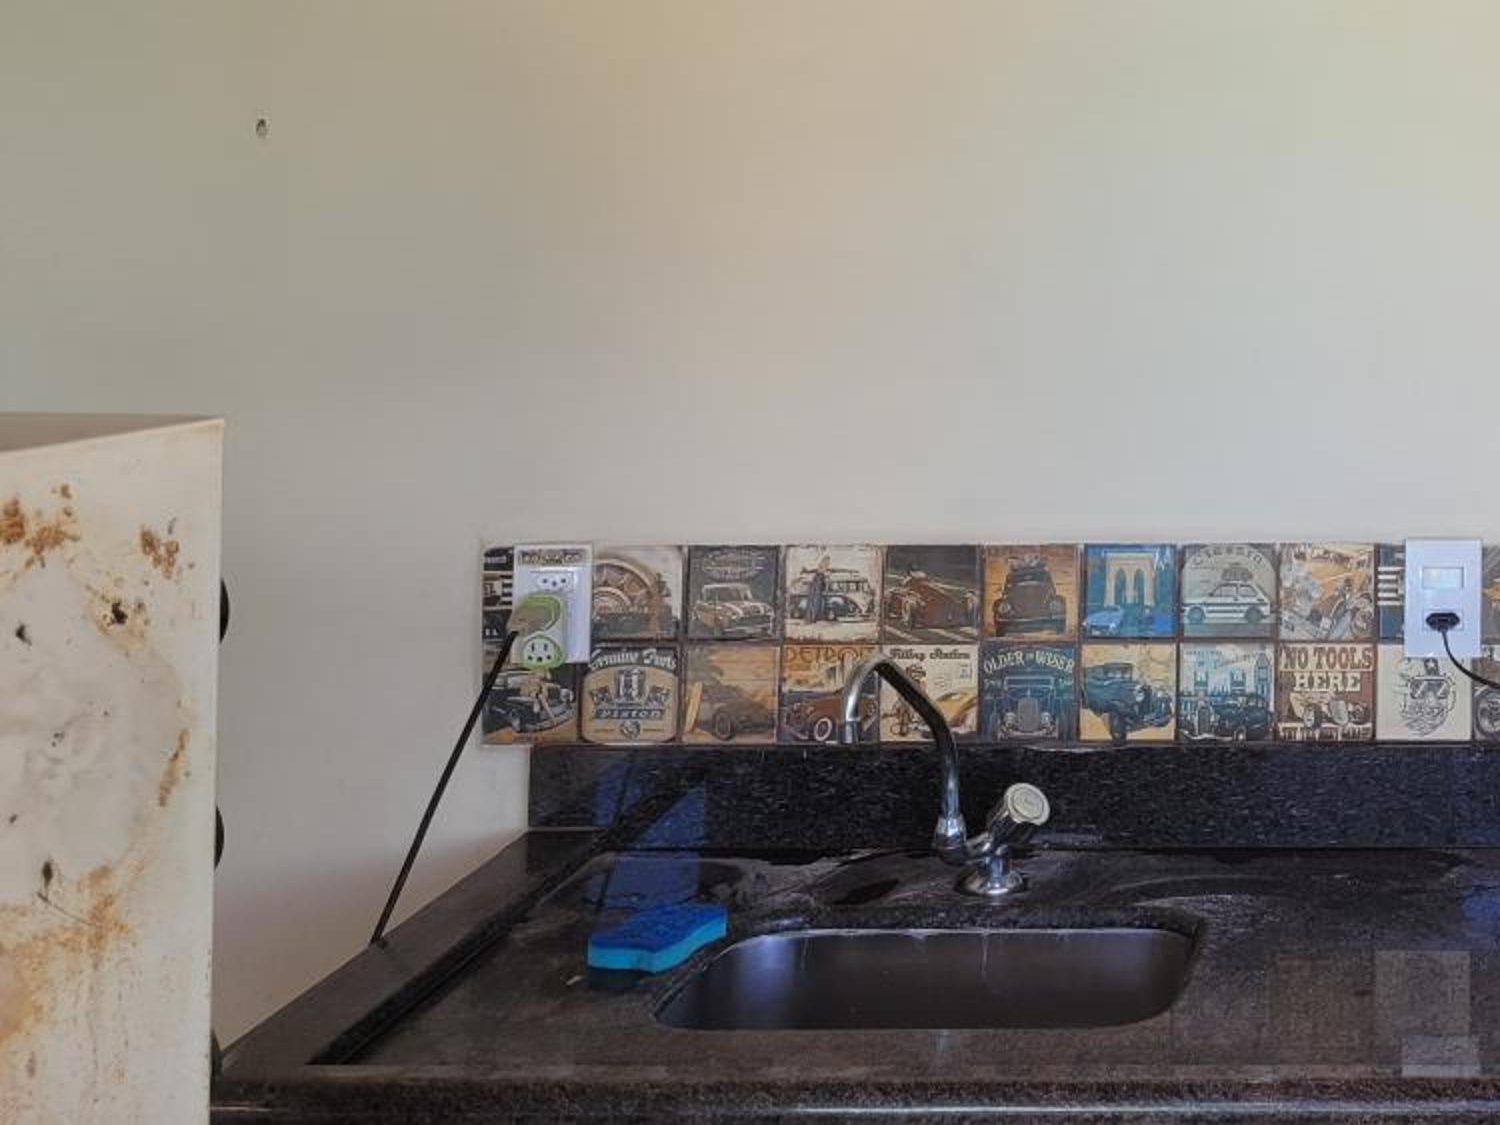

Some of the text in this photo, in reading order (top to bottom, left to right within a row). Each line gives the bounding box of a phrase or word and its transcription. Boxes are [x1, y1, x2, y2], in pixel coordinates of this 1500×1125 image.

[984, 650, 1025, 674] OLDER
[1284, 647, 1372, 669] NO TOOLS
[1294, 672, 1361, 691] HERE
